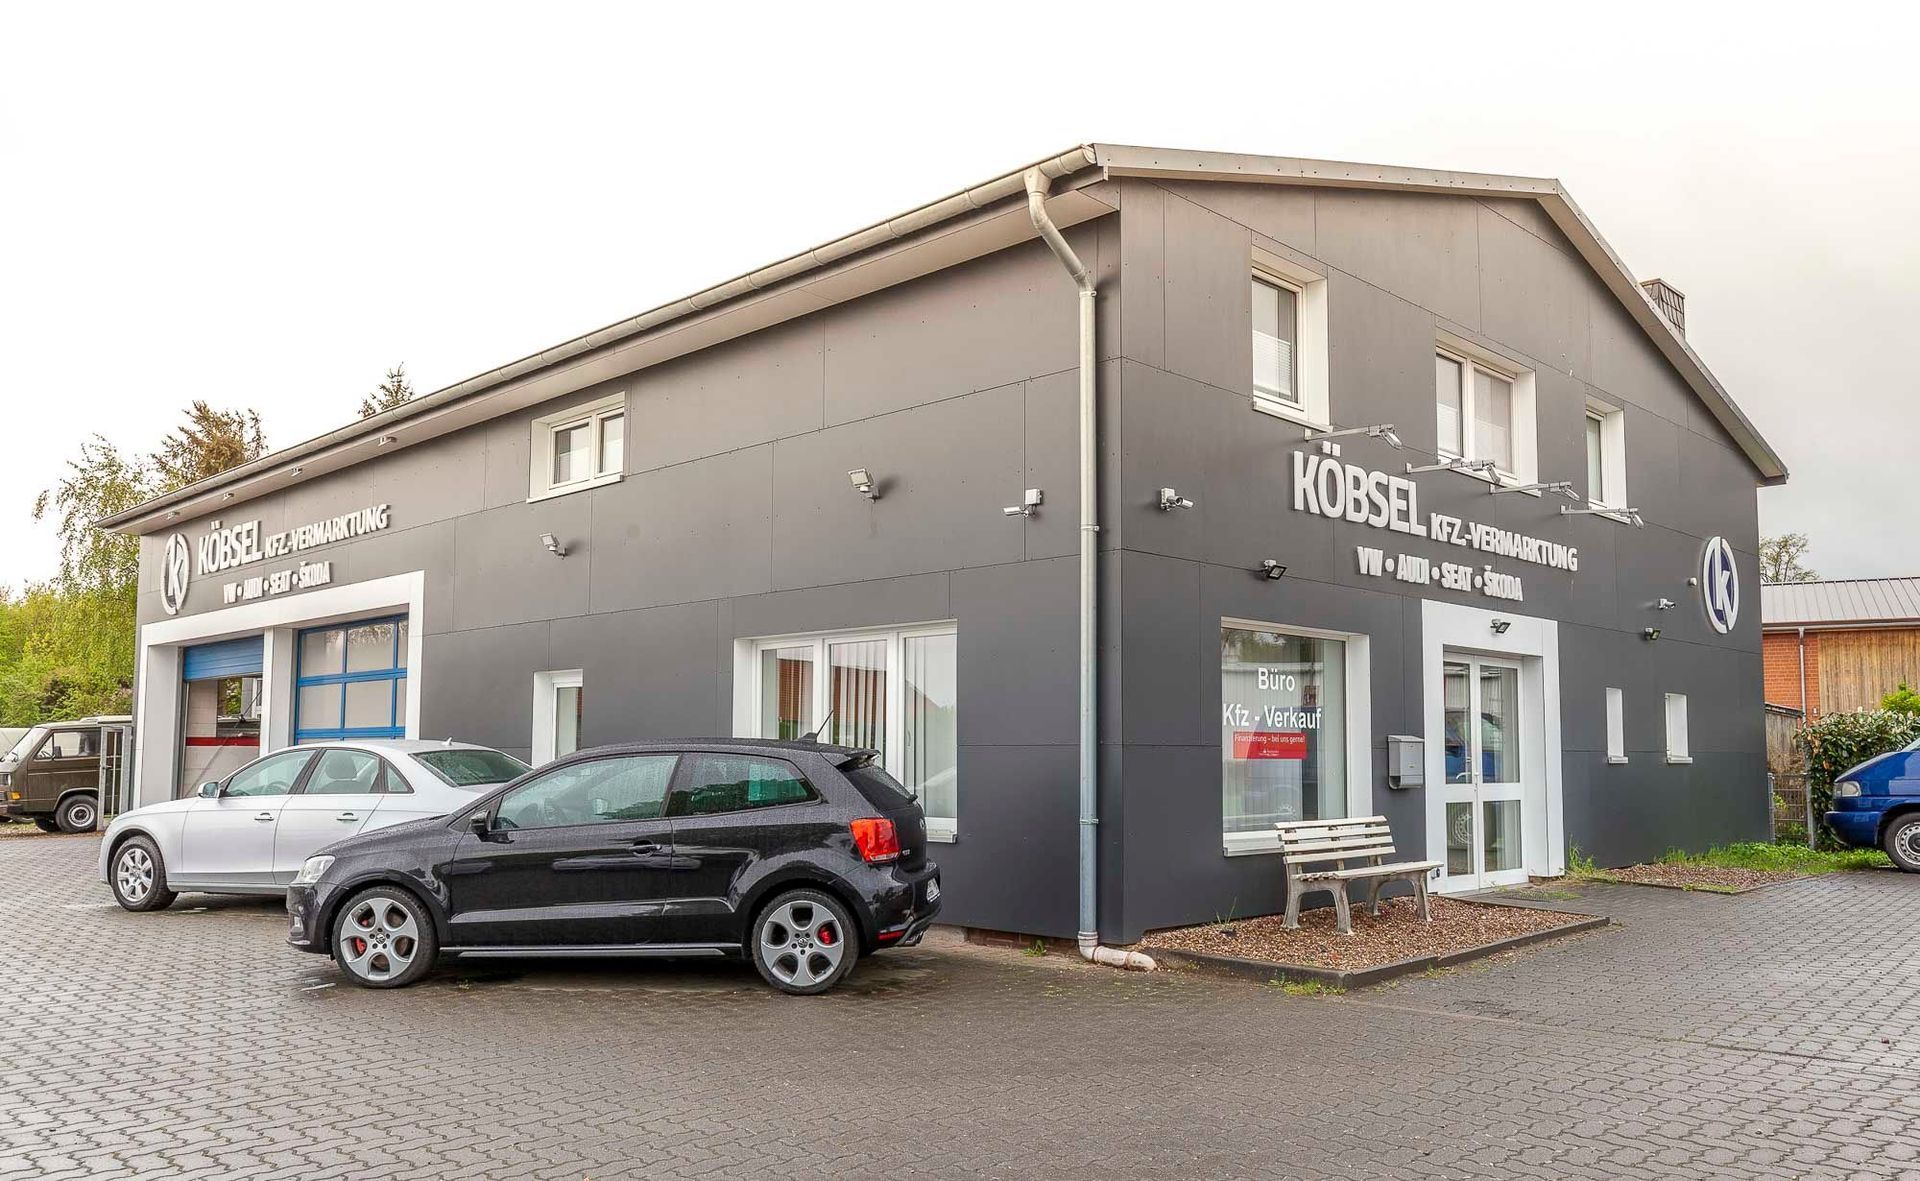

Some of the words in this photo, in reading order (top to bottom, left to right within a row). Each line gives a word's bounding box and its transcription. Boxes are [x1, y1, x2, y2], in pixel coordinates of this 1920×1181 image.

[1292, 441, 1427, 538] KÖBSEL
[197, 519, 264, 576] KÖBSEL
[269, 569, 293, 595] SEAT
[1356, 546, 1384, 577] VW
[1396, 553, 1431, 585] AUDI
[1441, 561, 1473, 592] SEAT
[1483, 565, 1524, 602] ŠKODA
[1258, 667, 1296, 692] Büro
[1222, 703, 1250, 727] Kfz
[1263, 704, 1322, 730] Verkauf
[1234, 733, 1268, 745] Finanzierung
